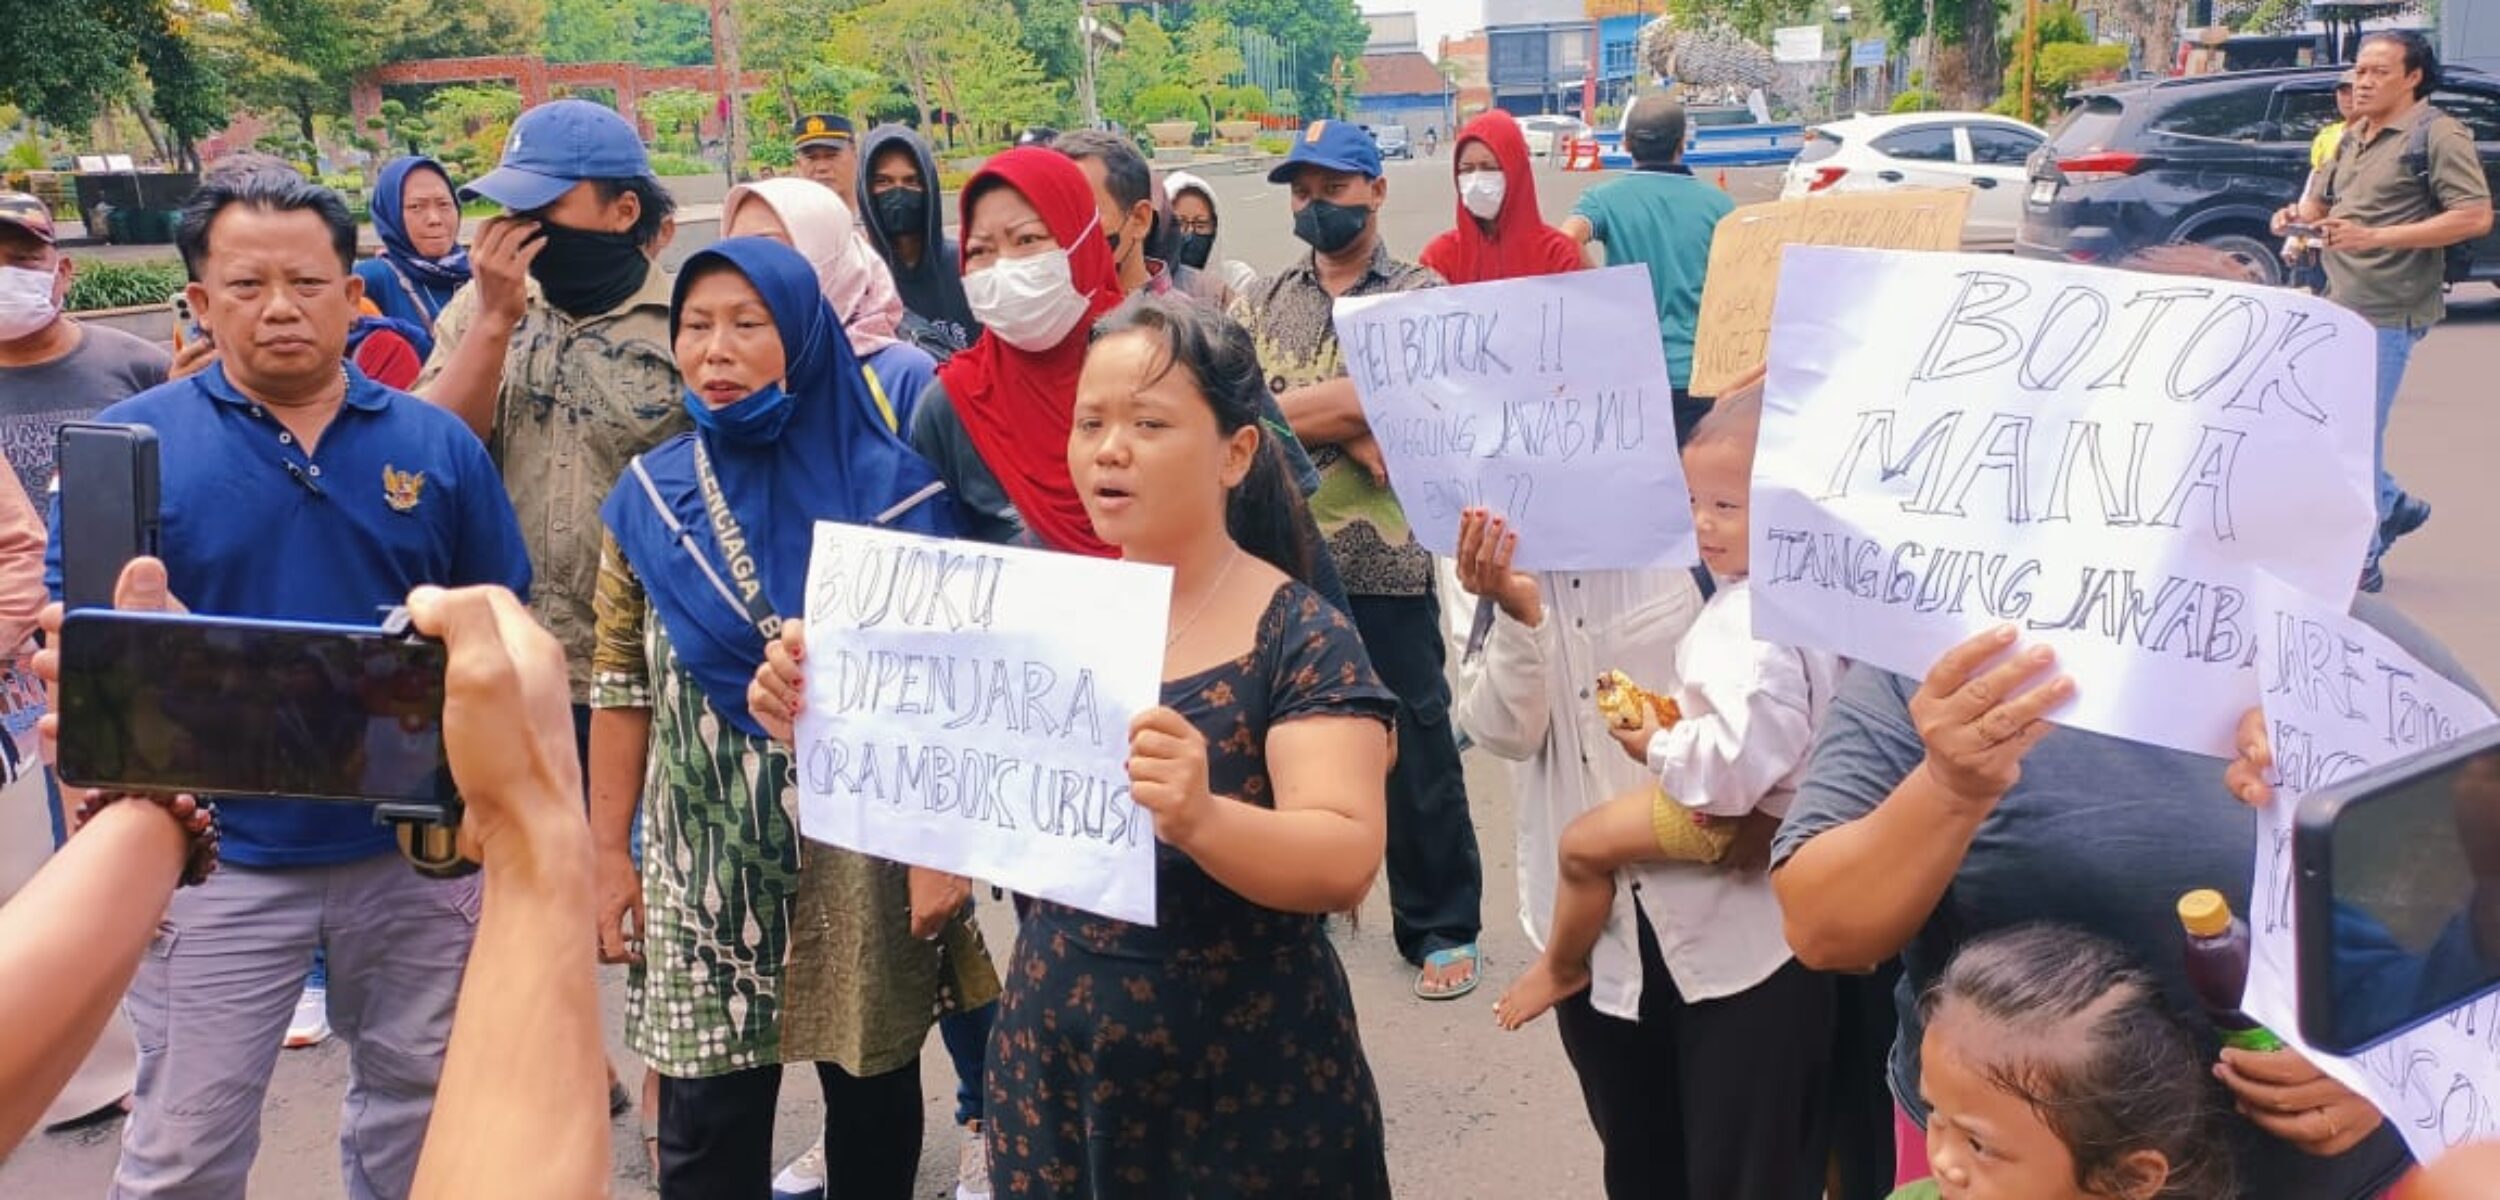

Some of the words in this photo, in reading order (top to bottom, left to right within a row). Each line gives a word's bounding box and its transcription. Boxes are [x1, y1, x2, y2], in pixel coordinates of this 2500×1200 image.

[1400, 311, 1512, 386] BOTOK
[1905, 271, 2337, 424] BOTOK
[1814, 409, 2247, 541] MANA
[811, 536, 1004, 631] BOJOKU
[1767, 528, 2042, 619] TANGGUNG
[2027, 566, 2258, 669] JAWAB
[836, 650, 1102, 745] DIPENJARA
[807, 738, 885, 799] ORA
[892, 744, 1020, 830] MBOK
